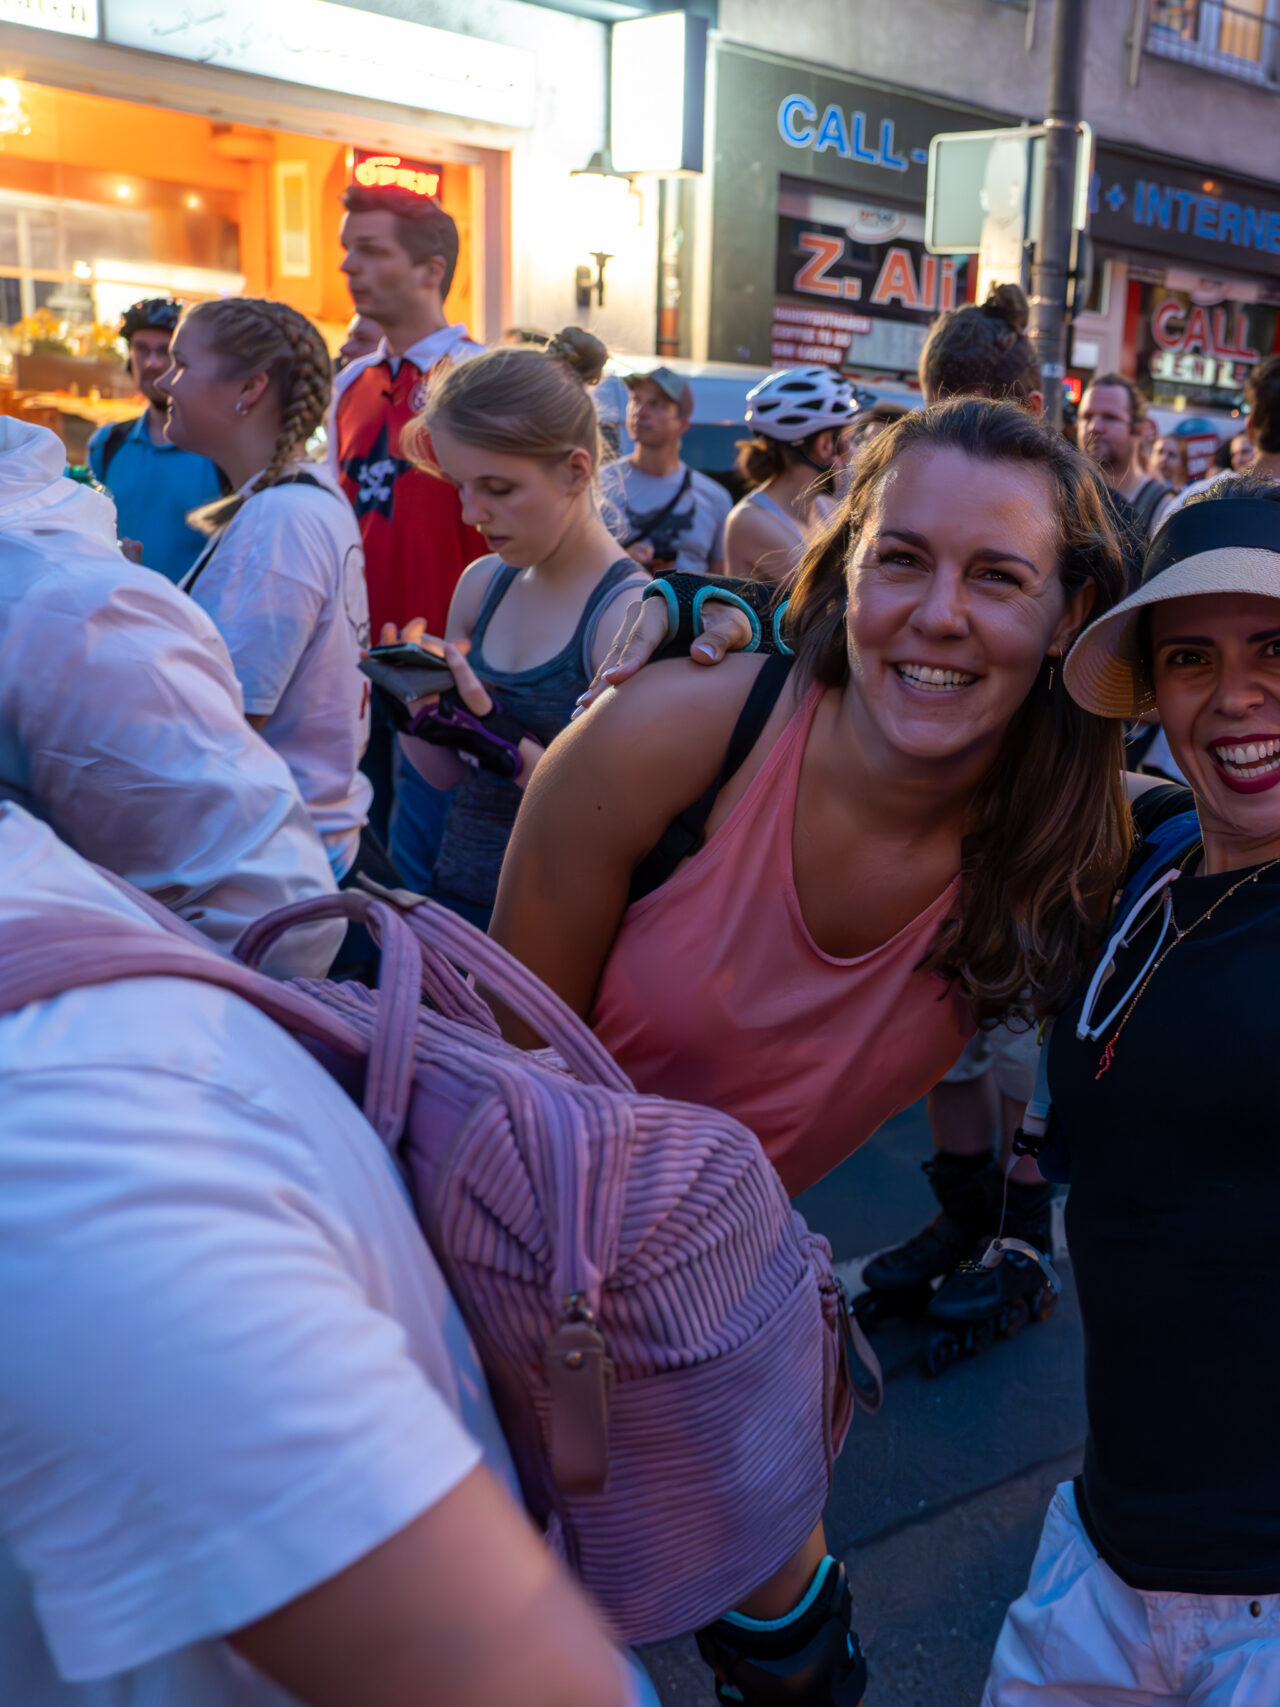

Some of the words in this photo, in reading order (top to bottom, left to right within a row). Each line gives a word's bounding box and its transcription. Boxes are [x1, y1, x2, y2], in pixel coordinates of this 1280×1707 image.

[794, 231, 862, 301] Z.
[869, 247, 958, 313] Ali
[1153, 300, 1258, 363] CALL
